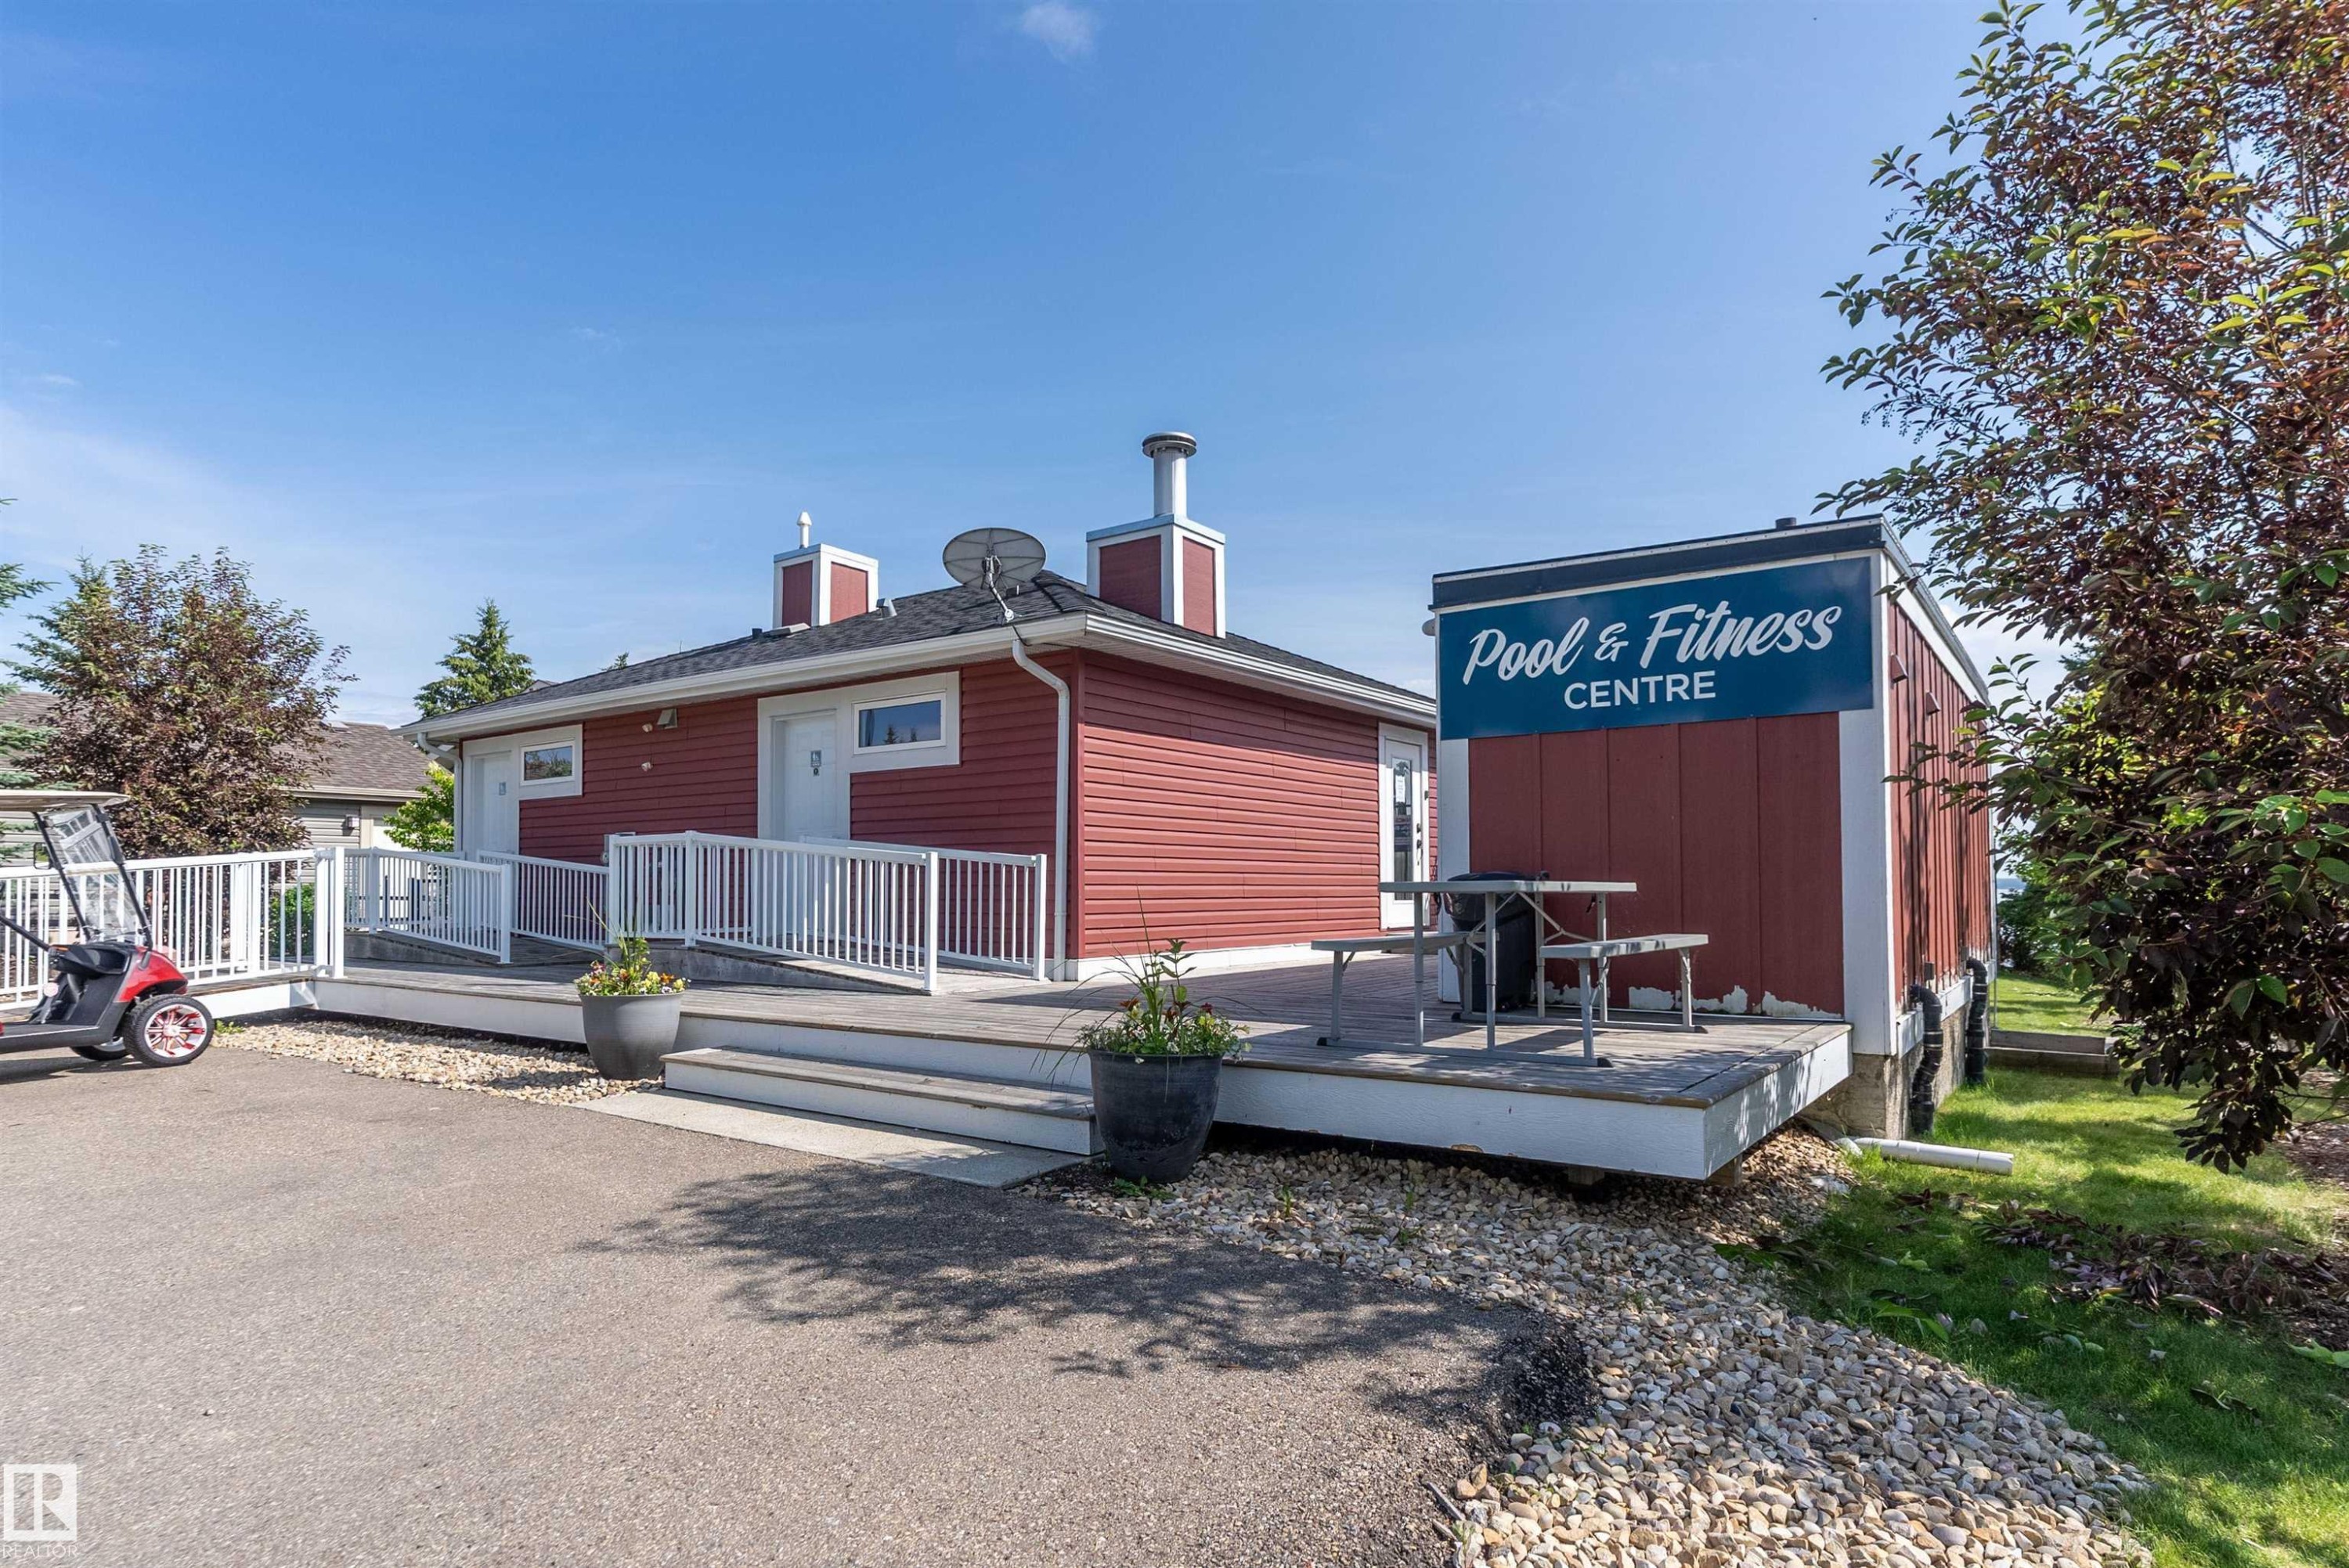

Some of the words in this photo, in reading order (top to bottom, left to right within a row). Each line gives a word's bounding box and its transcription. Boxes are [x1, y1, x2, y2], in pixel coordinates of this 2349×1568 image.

[1463, 616, 1589, 685] Pool
[1594, 622, 1629, 662] &
[1640, 600, 1842, 669] Fitness
[1564, 670, 1716, 709] CENTRE
